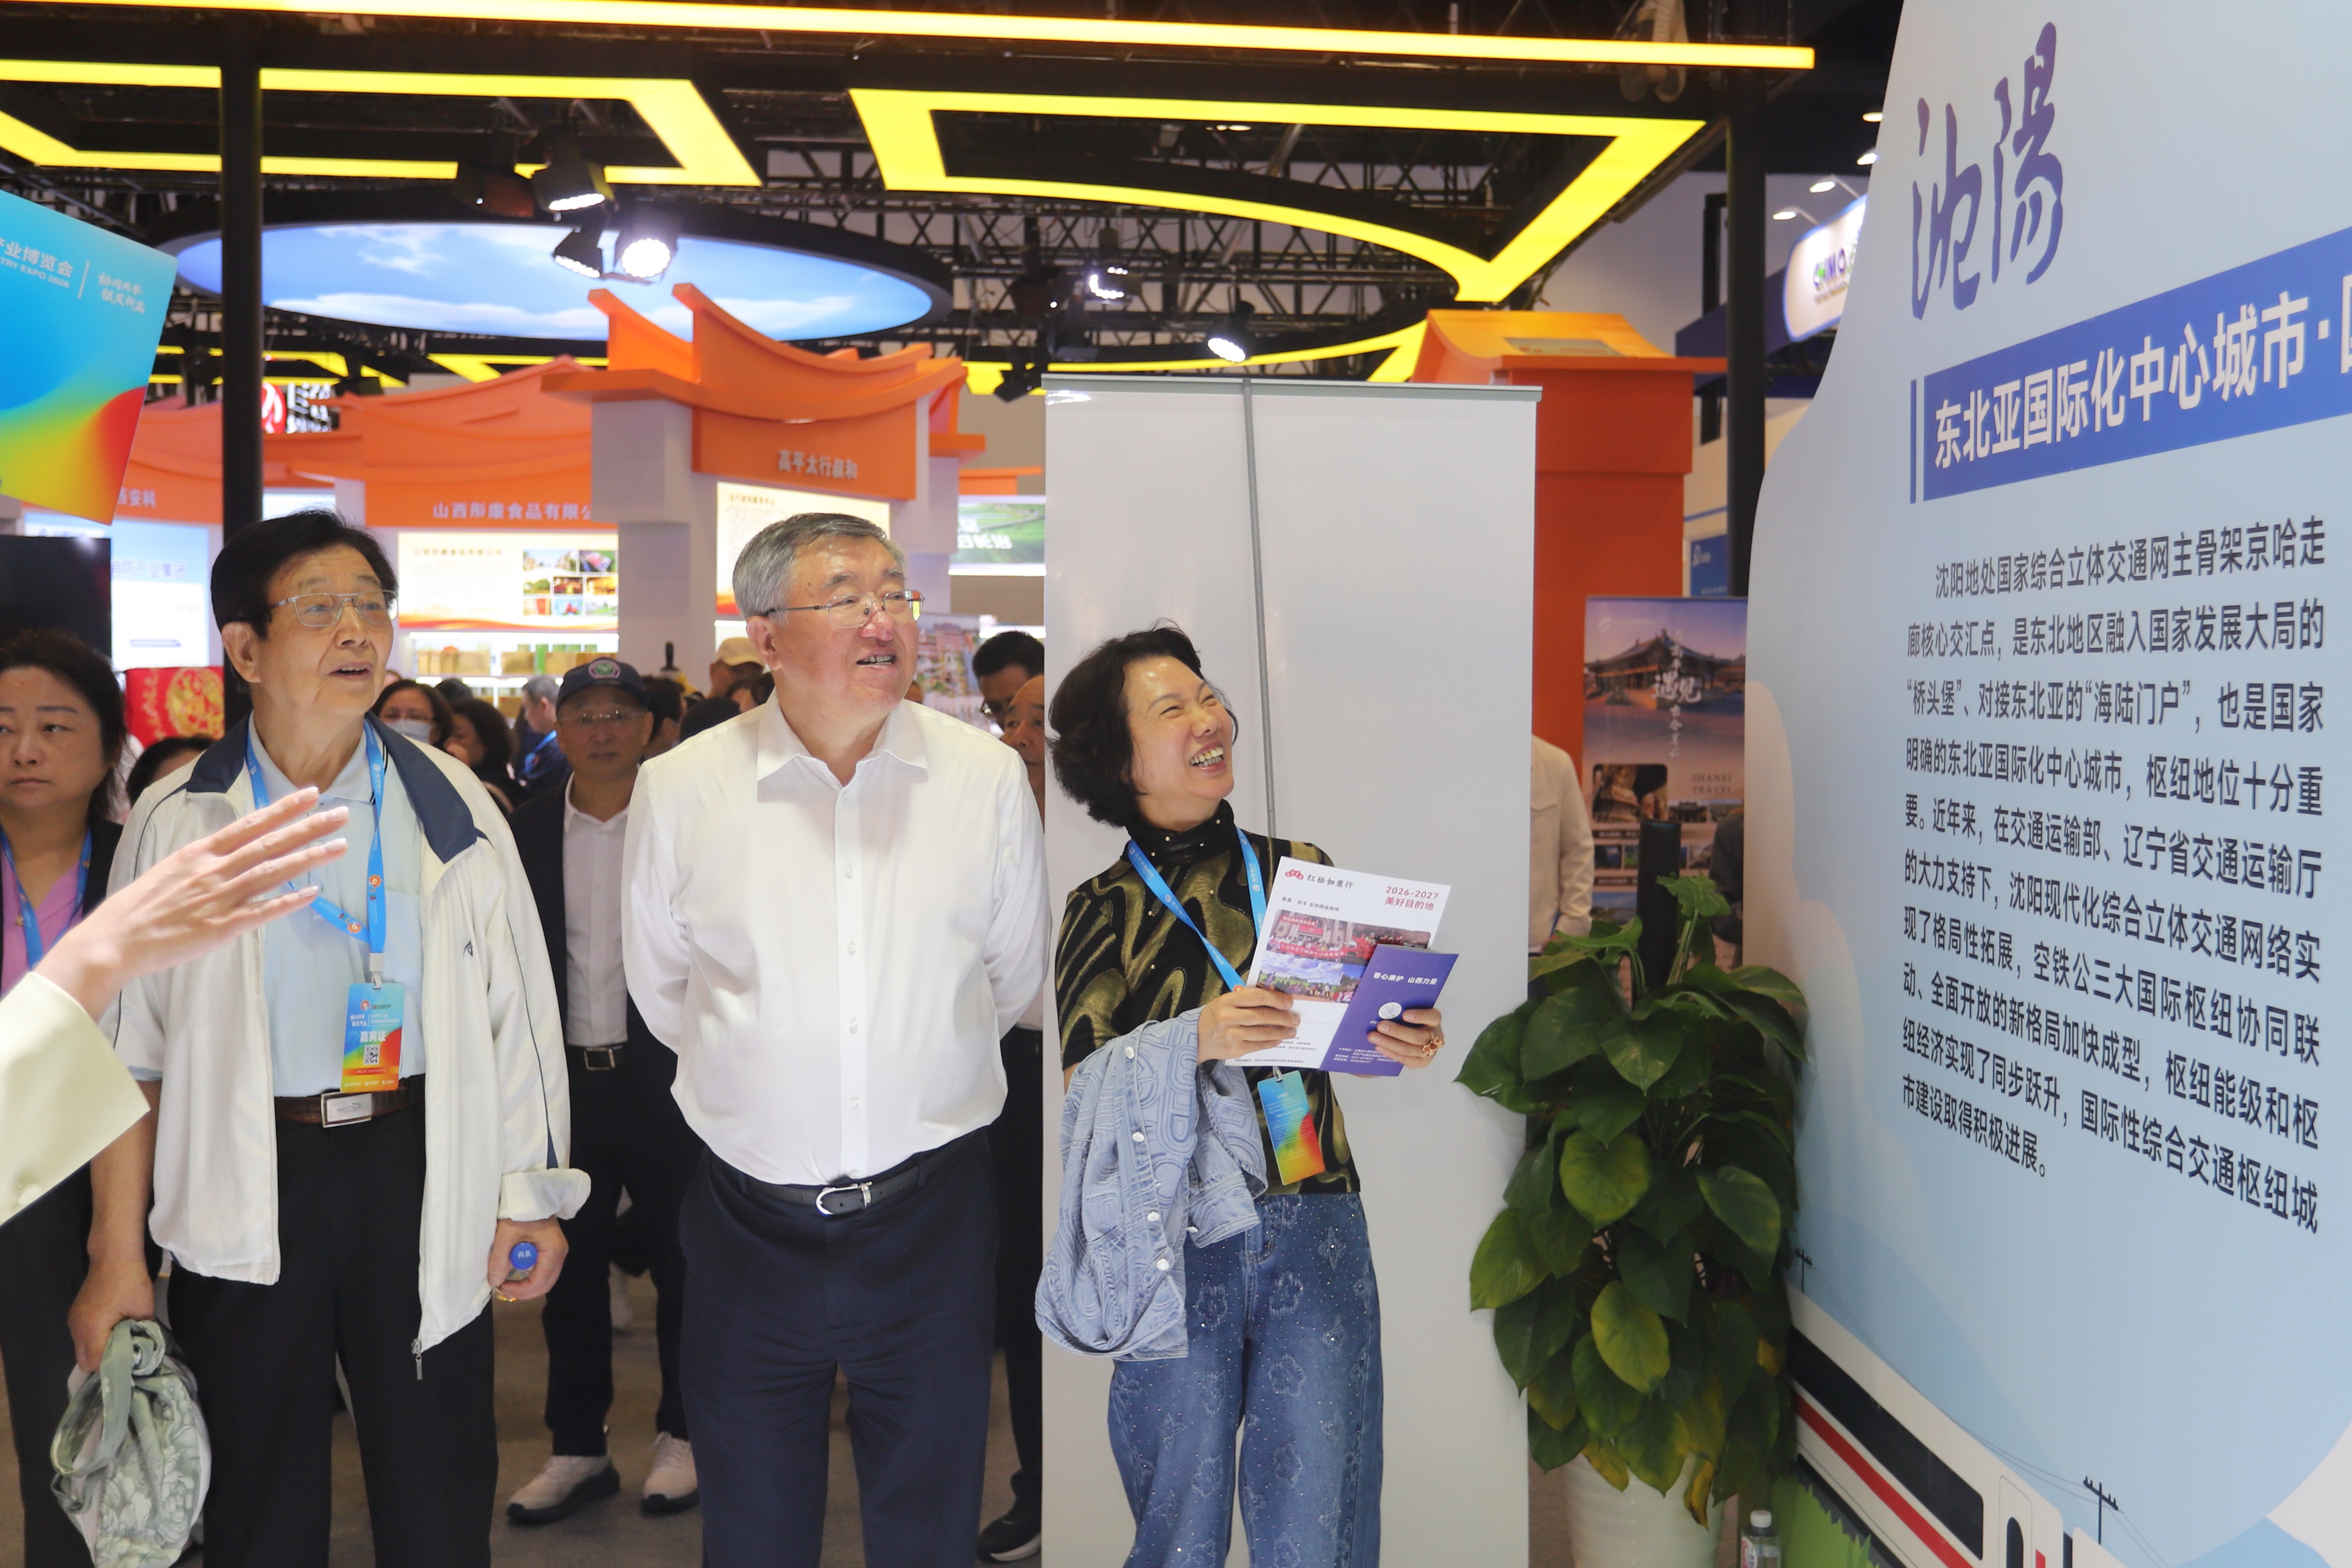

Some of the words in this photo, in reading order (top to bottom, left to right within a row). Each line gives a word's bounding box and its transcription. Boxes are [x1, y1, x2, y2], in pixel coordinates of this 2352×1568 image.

[0, 237, 74, 278] 业博览会
[20, 264, 47, 280] EXPO
[48, 275, 70, 288] 2026
[1935, 515, 2325, 598] 沈阳地处国家综合立体交通网主骨架京哈走
[1907, 597, 2323, 660] 廊核心交汇点，是东北地区融入国家发展大局的
[1692, 773, 1732, 783] SHANXI
[1692, 786, 1733, 794] TRAVEL
[1906, 738, 2322, 816] 明确的东北亚国际化中心城市，枢纽地位十分重
[1905, 793, 2322, 899] 要。近年来，在交通运输部、辽宁省交通运输厅
[1385, 886, 1440, 900] 2026-2027
[1385, 896, 1435, 911] 美好目的地
[1904, 848, 2320, 984] 的大力支持下，沈阳现代化综合立体交通网络实
[1407, 977, 1438, 986] 山西力量
[1903, 906, 2319, 1067] 现了格局性拓展，空铁公三大国际枢纽协同联
[360, 1030, 387, 1043] 嘉宾证
[1903, 962, 2318, 1150] 动、全面开放的新格局加快成型，枢纽能级和枢
[1903, 1016, 2318, 1234] 纽经济实现了同步跃升，国际性综合交通枢纽城
[1903, 1073, 2046, 1177] 市建设取得积极进展。
